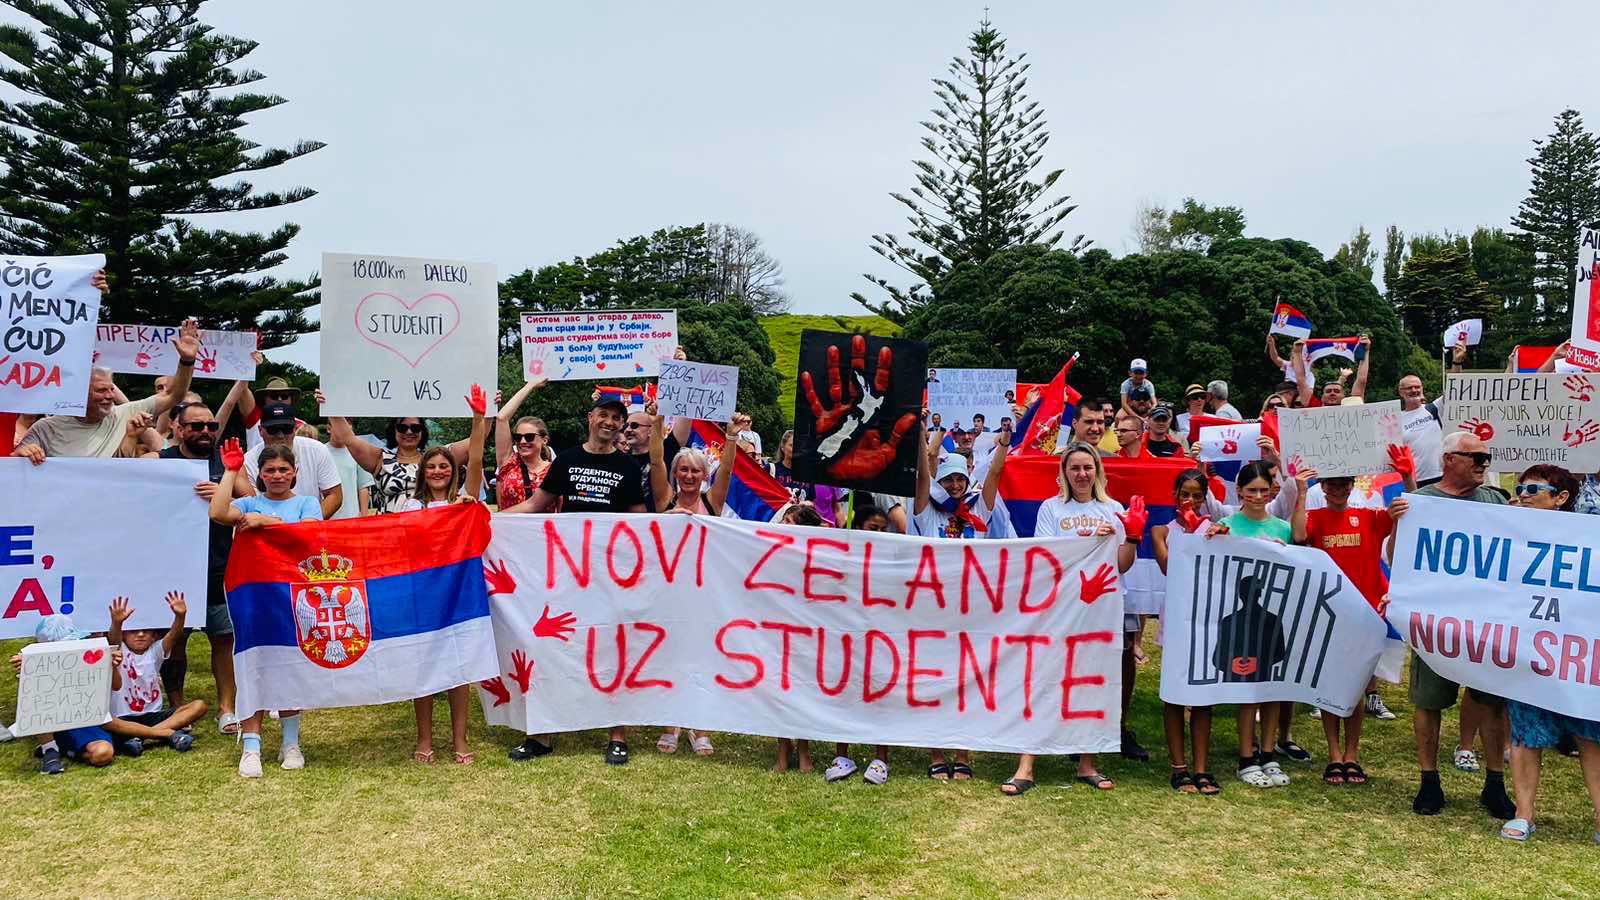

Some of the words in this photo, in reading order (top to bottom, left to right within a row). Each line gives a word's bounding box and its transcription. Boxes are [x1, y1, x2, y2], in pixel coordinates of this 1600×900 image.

[0, 260, 54, 290] ČIĆ
[9, 291, 88, 325] MENJA
[526, 315, 560, 324] Систем
[564, 314, 581, 323] нас
[586, 313, 595, 324] је
[4, 316, 65, 356] ĆUD
[524, 335, 565, 344] Подршка
[566, 333, 618, 342] студентима
[620, 332, 638, 341] који
[651, 330, 672, 340] боре
[536, 325, 553, 333] али
[555, 325, 576, 334] срце
[596, 323, 605, 334] је
[568, 344, 593, 354] бољу
[597, 342, 644, 352] будућност
[569, 354, 597, 363] својој
[659, 362, 696, 383] ZBOG
[700, 368, 729, 386] VAS
[368, 380, 392, 400] UZ
[413, 380, 442, 401] VAS
[686, 387, 724, 406] TETKA
[672, 403, 687, 416] SA
[694, 406, 717, 420] NZ
[1448, 405, 1472, 421] LIFT
[1480, 405, 1493, 421] UP
[1499, 404, 1530, 421] YOUR
[568, 467, 612, 478] СТУДЕНТИ
[613, 472, 624, 481] СУ
[570, 475, 620, 487] БУДУЋНОСТ
[543, 518, 706, 589] NOVI
[743, 529, 1063, 615] ZELAND
[1414, 528, 1511, 582] NOVI
[1522, 541, 1600, 593] ZEL
[1530, 595, 1560, 622] ZA
[1409, 611, 1519, 669] NOVU
[24, 653, 78, 675] САМО
[585, 622, 674, 694] UZ
[714, 618, 1114, 722] STUDENTE
